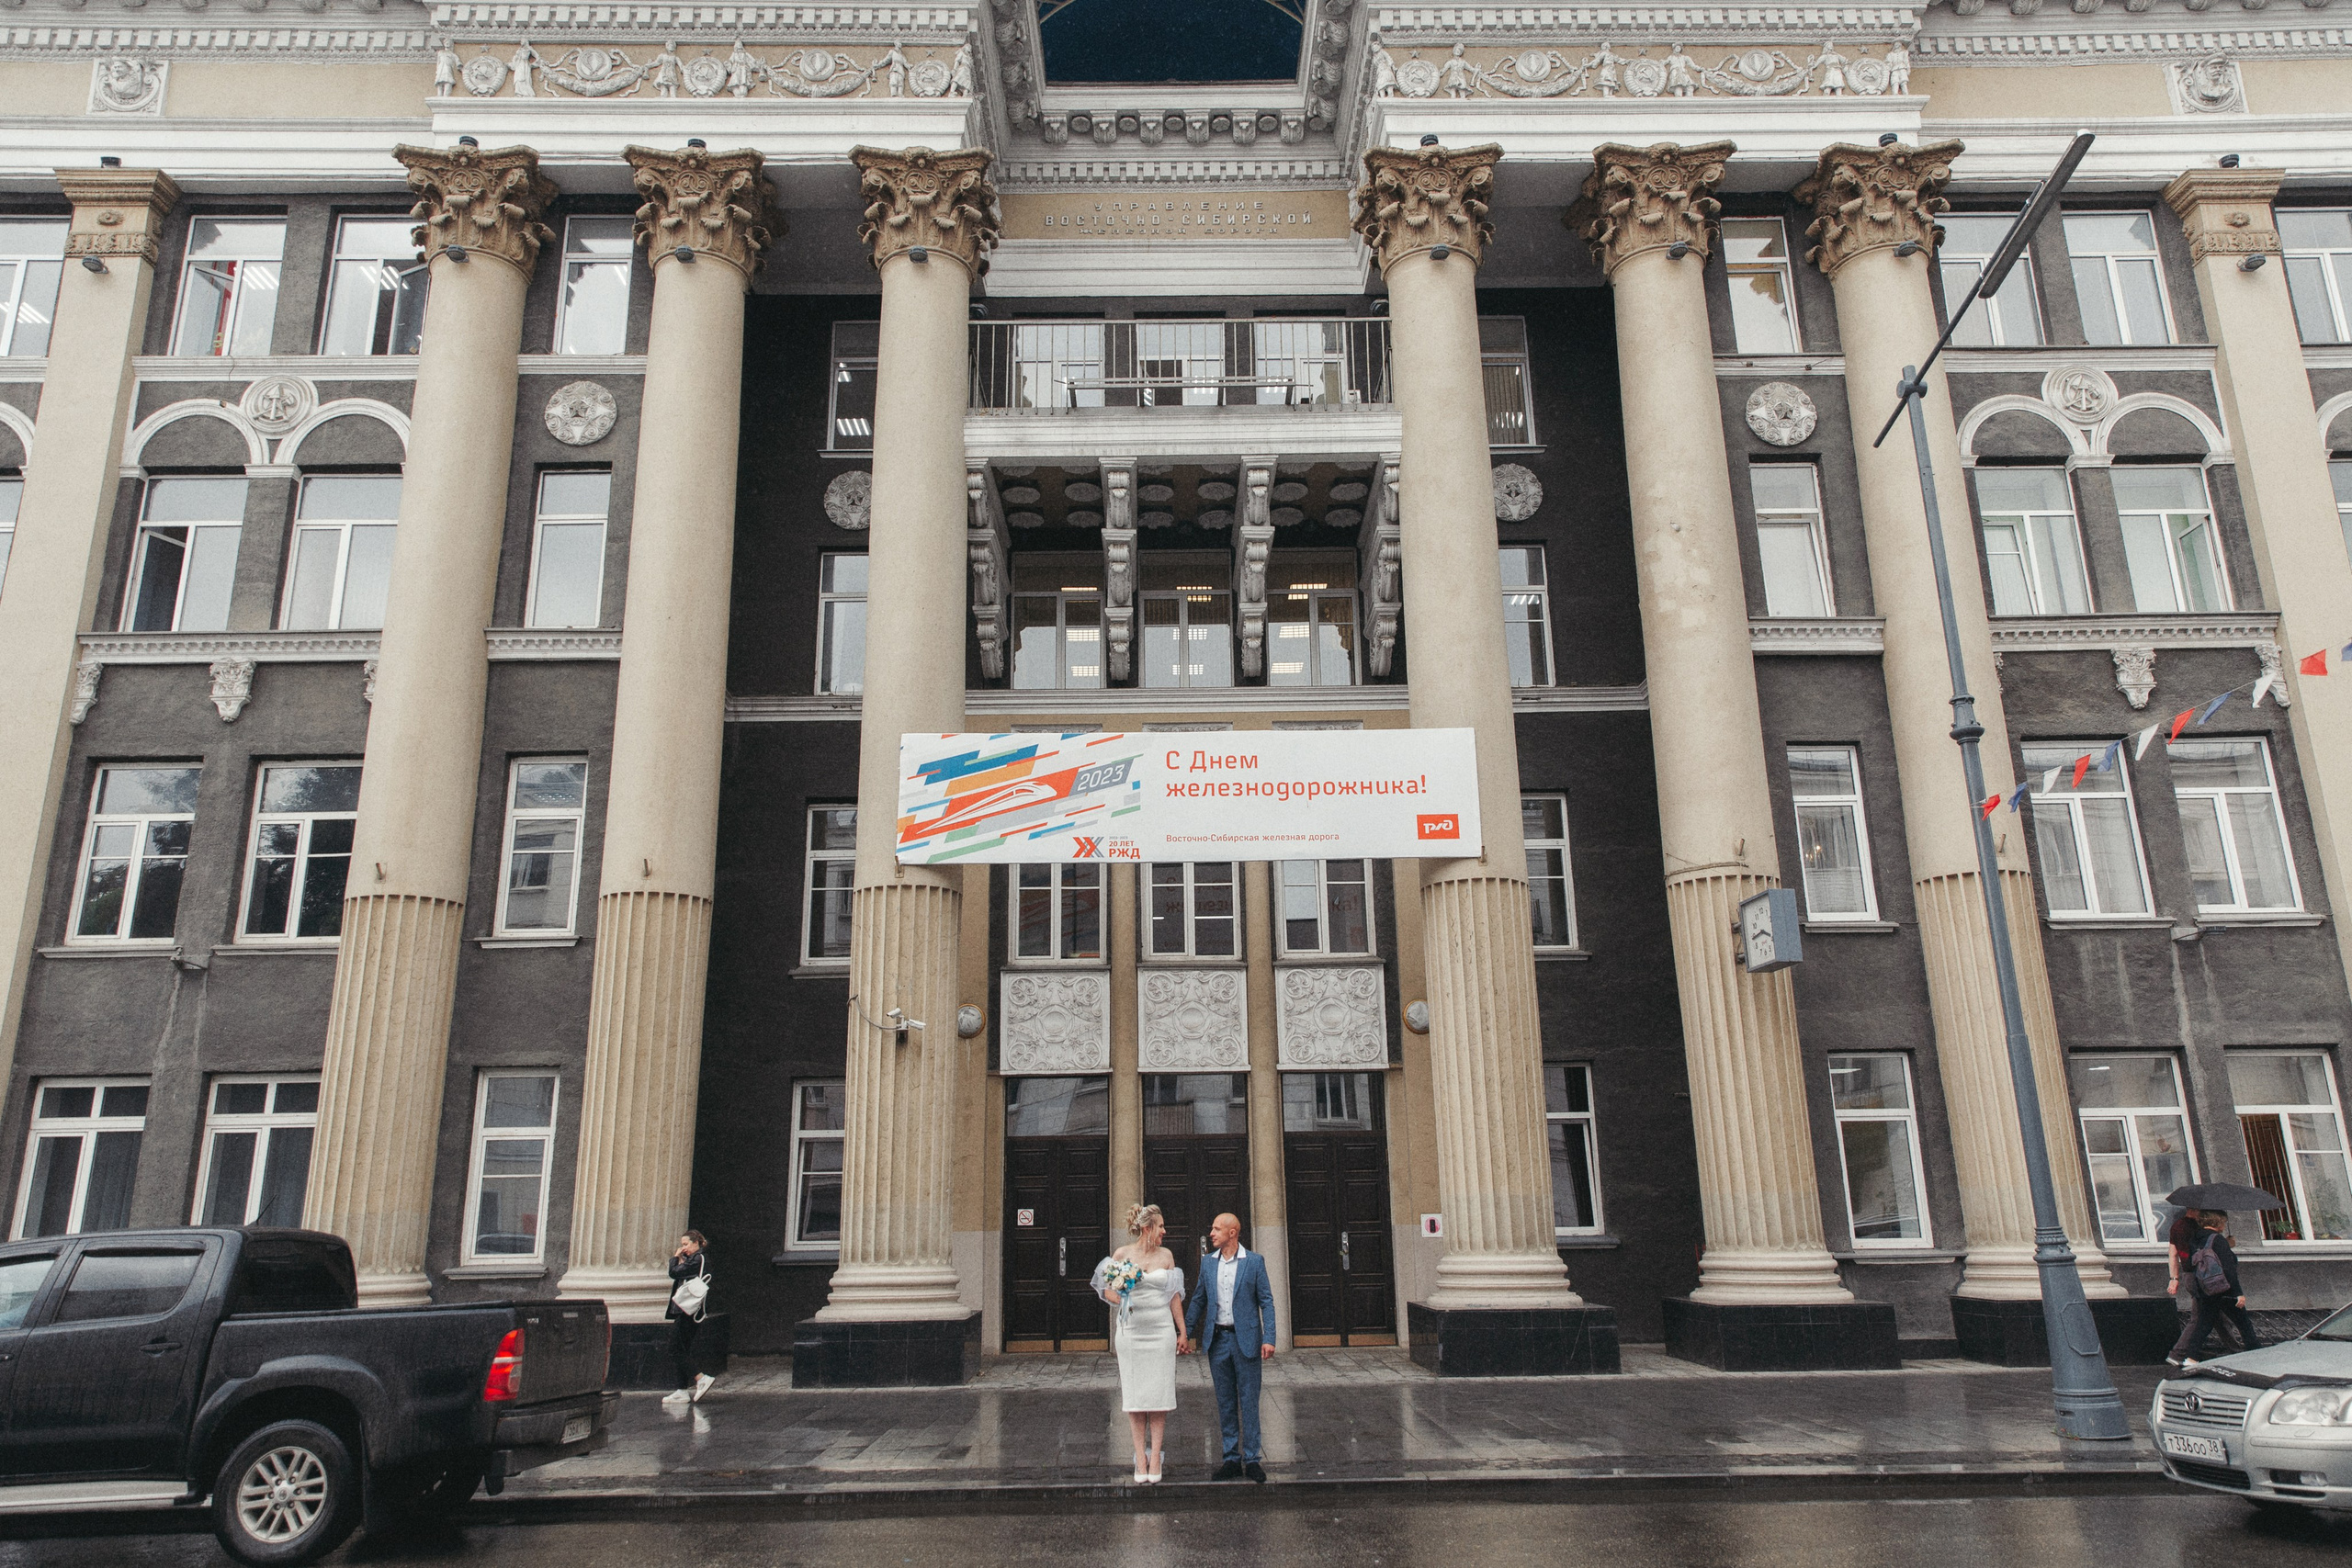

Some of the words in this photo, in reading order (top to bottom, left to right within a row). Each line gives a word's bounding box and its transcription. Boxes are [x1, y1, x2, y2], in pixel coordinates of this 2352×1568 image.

[1094, 201, 1263, 211] УПРАВЛЕНИЕ
[1045, 209, 1311, 226] ВОСТОЧНО-СИБИРСКОЙ
[1165, 750, 1181, 770] С
[1189, 750, 1259, 773] Днем
[1077, 763, 1125, 792] 2023
[1165, 774, 1428, 801] железнодорожника!
[1166, 833, 1260, 843] Восточно-Сибирская
[1261, 833, 1306, 841] железная
[1308, 833, 1340, 842] дорога
[1108, 848, 1141, 859] РЖД
[2207, 1439, 2218, 1452] 38
